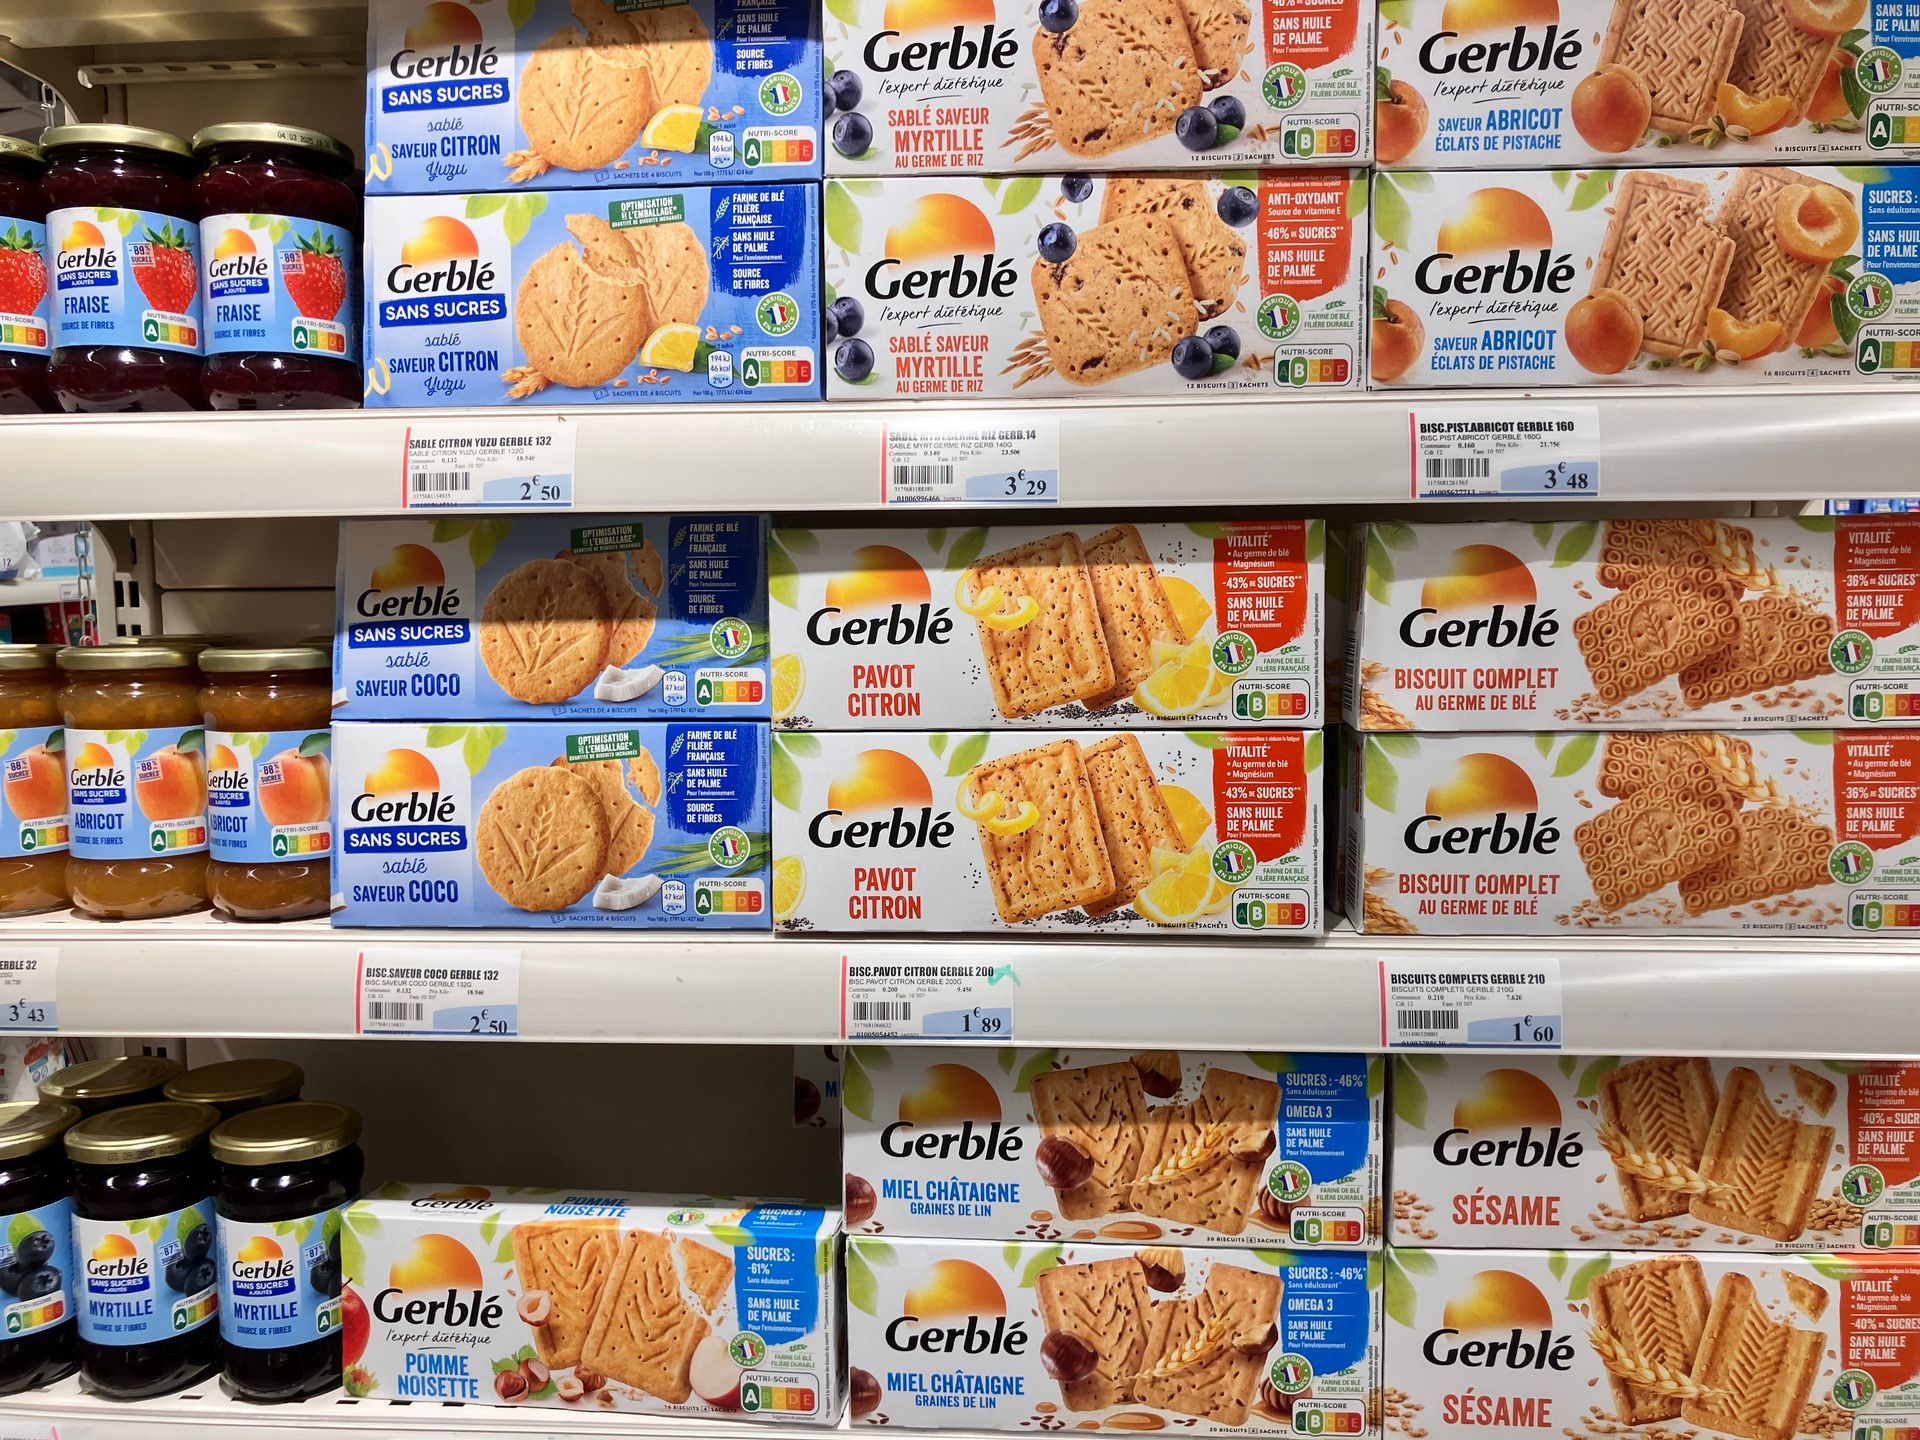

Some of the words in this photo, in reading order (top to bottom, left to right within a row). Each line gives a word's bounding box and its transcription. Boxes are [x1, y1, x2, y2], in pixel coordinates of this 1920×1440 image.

[863, 25, 1018, 72] Gerblé
[1418, 26, 1583, 73] Gerblé
[390, 46, 499, 80] Gerblé
[388, 88, 432, 106] SANS
[437, 83, 503, 102] SUCRES
[1434, 80, 1487, 99] l'expert
[428, 118, 463, 132] sablé
[888, 104, 931, 127] SABLÉ
[936, 107, 989, 125] SAVEUR
[1438, 115, 1483, 133] SAVEUR
[1486, 107, 1563, 131] ABRICOT
[392, 142, 437, 158] SAVEUR
[441, 135, 500, 157] CITRON
[895, 130, 984, 152] MYRTILLE
[426, 163, 467, 182] Yuzu
[621, 197, 673, 211] OPTIMISATION
[733, 194, 757, 202] FARINE
[761, 193, 769, 201] DE
[771, 191, 784, 201] BLÉ
[733, 203, 759, 213] FILIÈRE
[733, 214, 772, 226] FRANÇAISE
[733, 232, 751, 241] SANS
[754, 232, 774, 240] HUILE
[1263, 228, 1289, 239] -46%
[733, 244, 742, 252] DE
[744, 243, 768, 252] PALME
[57, 248, 116, 270] Gerblé
[210, 256, 268, 278] Gerblé
[60, 272, 76, 280] SANS
[78, 271, 111, 280] SUCRES
[387, 263, 494, 294] Gerblé
[865, 256, 1017, 299] Gerblé
[1415, 249, 1575, 295] Gerblé
[64, 296, 110, 314] FRAISE
[217, 304, 261, 322] FRAISE
[385, 304, 430, 320] SANS
[435, 300, 500, 318] SUCRES
[880, 306, 929, 323] l'expert
[147, 312, 187, 322] NUTRI-SCORE
[425, 334, 461, 348] sablé
[889, 333, 932, 354] SABLÉ
[936, 336, 989, 353] SAVEUR
[1434, 337, 1477, 352] SAVEUR
[1482, 330, 1556, 351] ABRICOT
[390, 358, 435, 374] SAVEUR
[439, 351, 498, 372] CITRON
[896, 356, 983, 378] MYRTILLE
[1431, 352, 1474, 370] ÉCLATS
[1479, 356, 1493, 370] DE
[1498, 355, 1555, 369] PISTACHE
[424, 379, 466, 396] Yuzu
[897, 381, 909, 392] AU
[912, 380, 947, 392] GERME
[950, 380, 963, 392] DE
[966, 379, 984, 392] RIZ
[1517, 422, 1553, 432] GERBLE
[1555, 421, 1574, 432] 160
[410, 439, 437, 449] SABLE
[439, 438, 472, 448] CITRON
[475, 437, 497, 447] YUZU
[500, 437, 533, 447] GERBLE
[536, 436, 551, 445] 132
[1233, 561, 1274, 569] Magnésium
[1222, 577, 1248, 588] -43%
[357, 588, 459, 618] Gerblé
[354, 628, 397, 643] SANS
[401, 625, 464, 640] SUCRES
[806, 603, 953, 646] Gerblé
[1399, 605, 1559, 649] Gerblé
[386, 652, 430, 668] sablé
[356, 680, 407, 697] SAVEUR
[411, 674, 460, 697] COCO
[853, 664, 915, 689] PAVOT
[1395, 669, 1466, 690] BISCUIT
[1473, 667, 1558, 690] COMPLET
[848, 694, 921, 716] CITRON
[1415, 694, 1431, 711] AU
[1435, 694, 1485, 711] GERME
[1490, 694, 1508, 710] DE
[1512, 689, 1536, 710] BLÉ
[71, 768, 125, 787] Gerblé
[74, 790, 86, 798] SANS
[89, 789, 120, 797] SUCRES
[351, 793, 455, 823] Gerblé
[75, 813, 124, 830] ABRICOT
[808, 808, 954, 849] Gerblé
[350, 834, 394, 848] SANS
[399, 831, 460, 846] SUCRES
[1404, 812, 1560, 855] Gerblé
[383, 858, 427, 874] sablé
[854, 867, 915, 892] PAVOT
[1400, 875, 1471, 895] BISCUIT
[1475, 875, 1559, 895] COMPLET
[353, 886, 405, 902] SAVEUR
[409, 880, 458, 902] COCO
[849, 896, 921, 920] CITRON
[367, 968, 422, 979] BISC.SAVEUR
[424, 969, 447, 979] COCO
[450, 969, 481, 980] GERBLE
[483, 970, 498, 980] 132
[850, 966, 902, 977] BISC.PAVOT
[904, 967, 938, 976] CITRON
[940, 967, 973, 976] GERBLE
[976, 967, 994, 976] 200
[1391, 974, 1436, 984] BISCUITS
[1439, 974, 1488, 984] COMPLETS
[1491, 974, 1525, 984] GERBLE
[1528, 974, 1545, 984] 210
[880, 1121, 1023, 1161] Gerblé
[1433, 1127, 1583, 1168] Gerblé
[882, 1179, 921, 1200] MIEL
[926, 1175, 1020, 1203] CHÂTAIGNE
[1452, 1185, 1560, 1226] SÉSAME
[86, 1258, 148, 1276] Gerblé
[232, 1260, 294, 1278] Gerblé
[90, 1279, 109, 1287] SANS
[111, 1277, 143, 1286] SUCRES
[89, 1299, 153, 1317] MYRTILLE
[234, 1302, 298, 1320] MYRTILLE
[373, 1288, 501, 1328] Gerblé
[885, 1317, 1027, 1355] Gerblé
[1422, 1327, 1575, 1371] Gerblé
[406, 1353, 469, 1376] POMME
[397, 1376, 479, 1399] NOISETTE
[887, 1371, 926, 1392] MIEL
[931, 1368, 1024, 1395] CHÂTAIGNE
[916, 1395, 956, 1408] GRAINES
[960, 1396, 974, 1408] DE
[978, 1397, 996, 1409] LIN
[1443, 1387, 1552, 1427] SÉSAME
